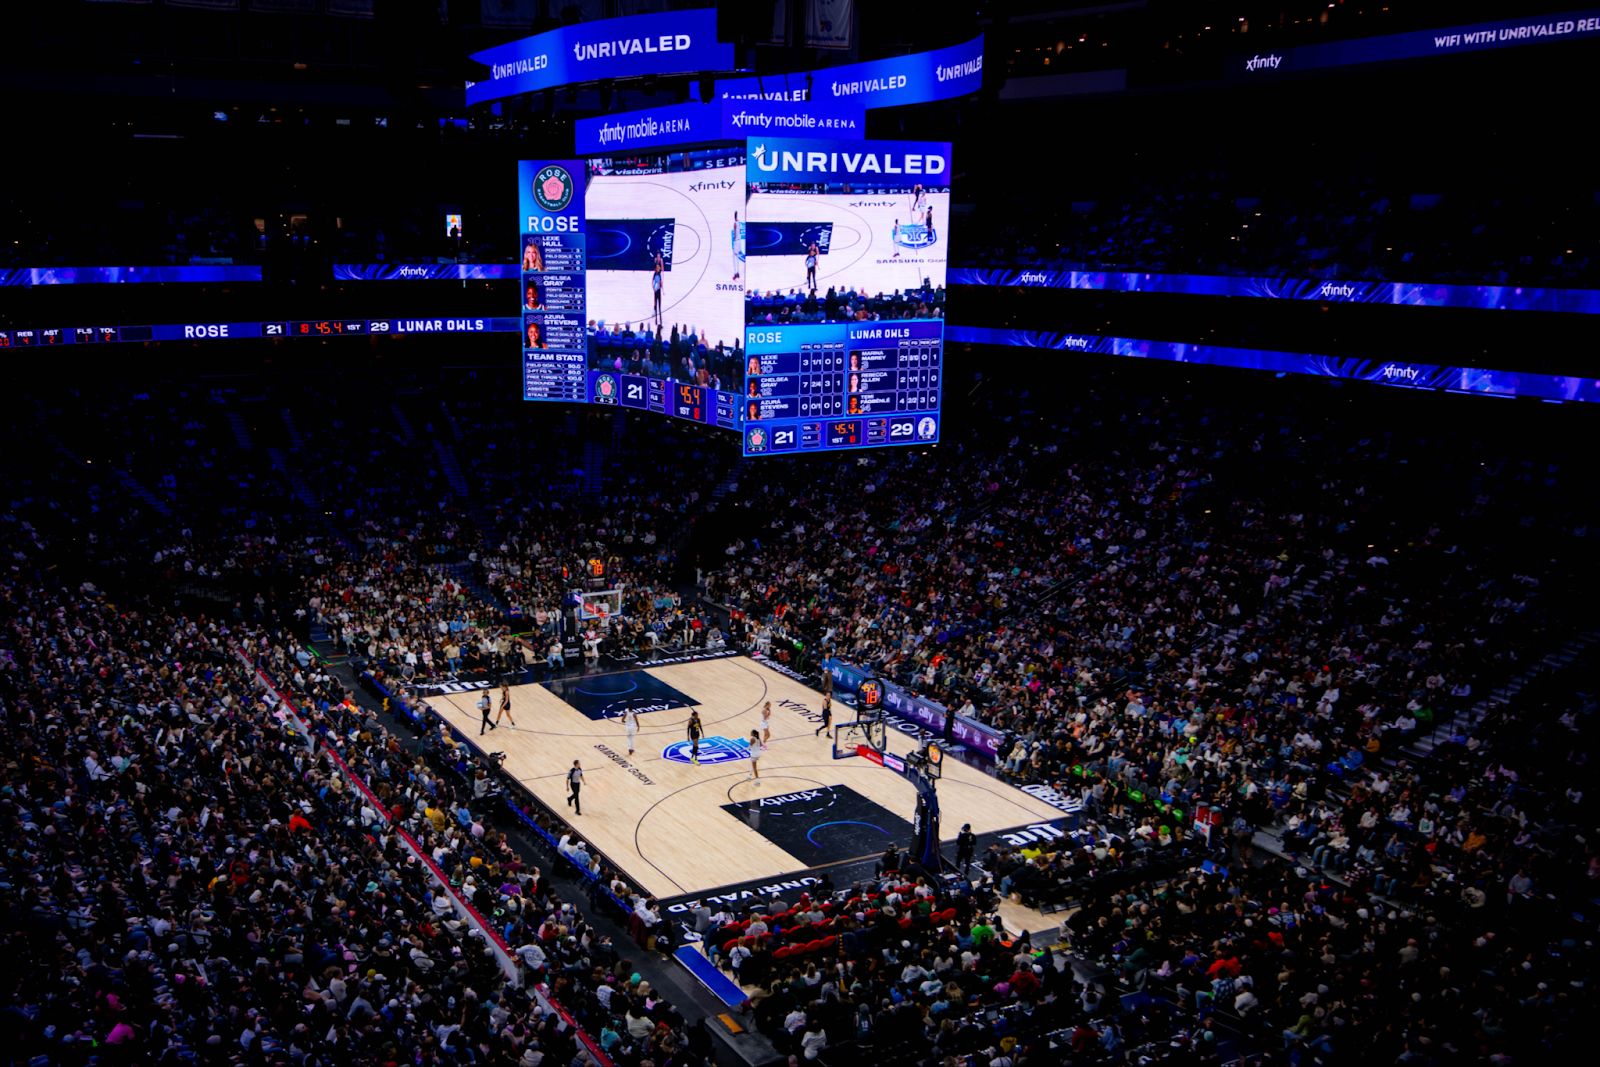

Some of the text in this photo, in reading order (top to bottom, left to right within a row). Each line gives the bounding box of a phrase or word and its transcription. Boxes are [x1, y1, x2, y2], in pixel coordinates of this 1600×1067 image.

[1434, 36, 1460, 48] WIFI
[1461, 31, 1496, 45] WITH
[1499, 20, 1574, 41] UNRIVALED
[574, 34, 692, 62] UNRIVALED
[493, 54, 548, 81] UNRIVALED
[1245, 54, 1283, 72] xfinity
[832, 75, 907, 97] UNRIVALED
[733, 111, 857, 129] xfinity mobile ARENA
[599, 116, 691, 145] xfinity mobile ARENA
[753, 150, 946, 174] UNRIVALED
[539, 169, 568, 182] ROSE
[688, 180, 735, 192] xfinity
[528, 216, 578, 232] ROSE
[660, 230, 674, 258] xfinity
[400, 266, 428, 278] xfinity
[1021, 272, 1047, 284] xfinity
[1321, 282, 1354, 298] xfinity
[185, 324, 228, 338] ROSE
[266, 324, 282, 334] 21
[315, 322, 342, 334] 45.4
[371, 321, 390, 332] 29
[398, 318, 484, 333] LUNAR OWLS
[748, 332, 782, 344] ROSE
[850, 328, 910, 341] LUNAR OWLS
[1065, 336, 1088, 349] xfinity
[1384, 364, 1419, 380] xfinity
[628, 384, 643, 399] 21
[680, 386, 700, 405] 45.4
[679, 407, 690, 415] 1ST
[835, 423, 855, 434] 45.4
[891, 423, 914, 436] 29
[775, 431, 794, 444] 21
[887, 692, 902, 708] ally
[918, 706, 934, 723] ally
[594, 744, 632, 768] SAMSUNG
